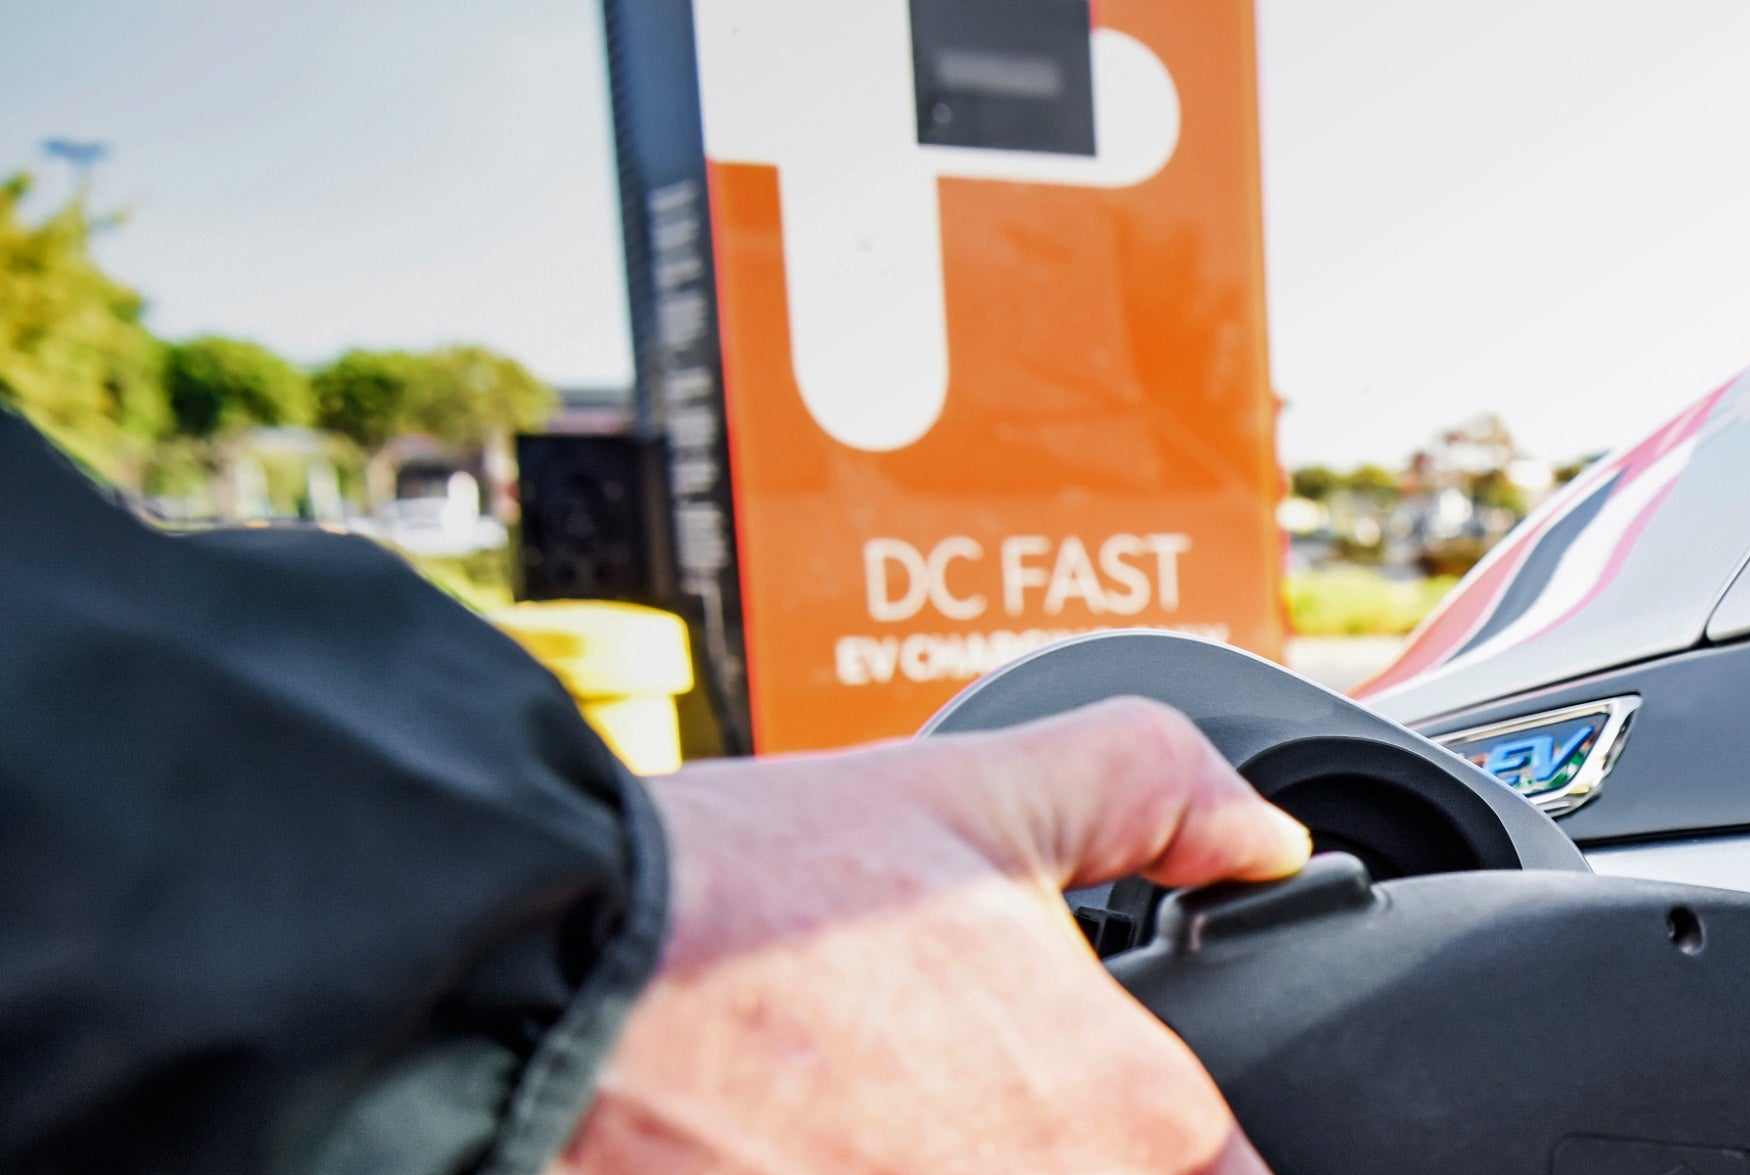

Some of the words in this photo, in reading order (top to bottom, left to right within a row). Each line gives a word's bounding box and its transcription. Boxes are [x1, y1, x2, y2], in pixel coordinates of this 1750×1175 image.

[863, 536, 987, 622] DC
[1001, 533, 1191, 617] FAST
[834, 634, 899, 686] EV
[1483, 725, 1595, 787] EV
